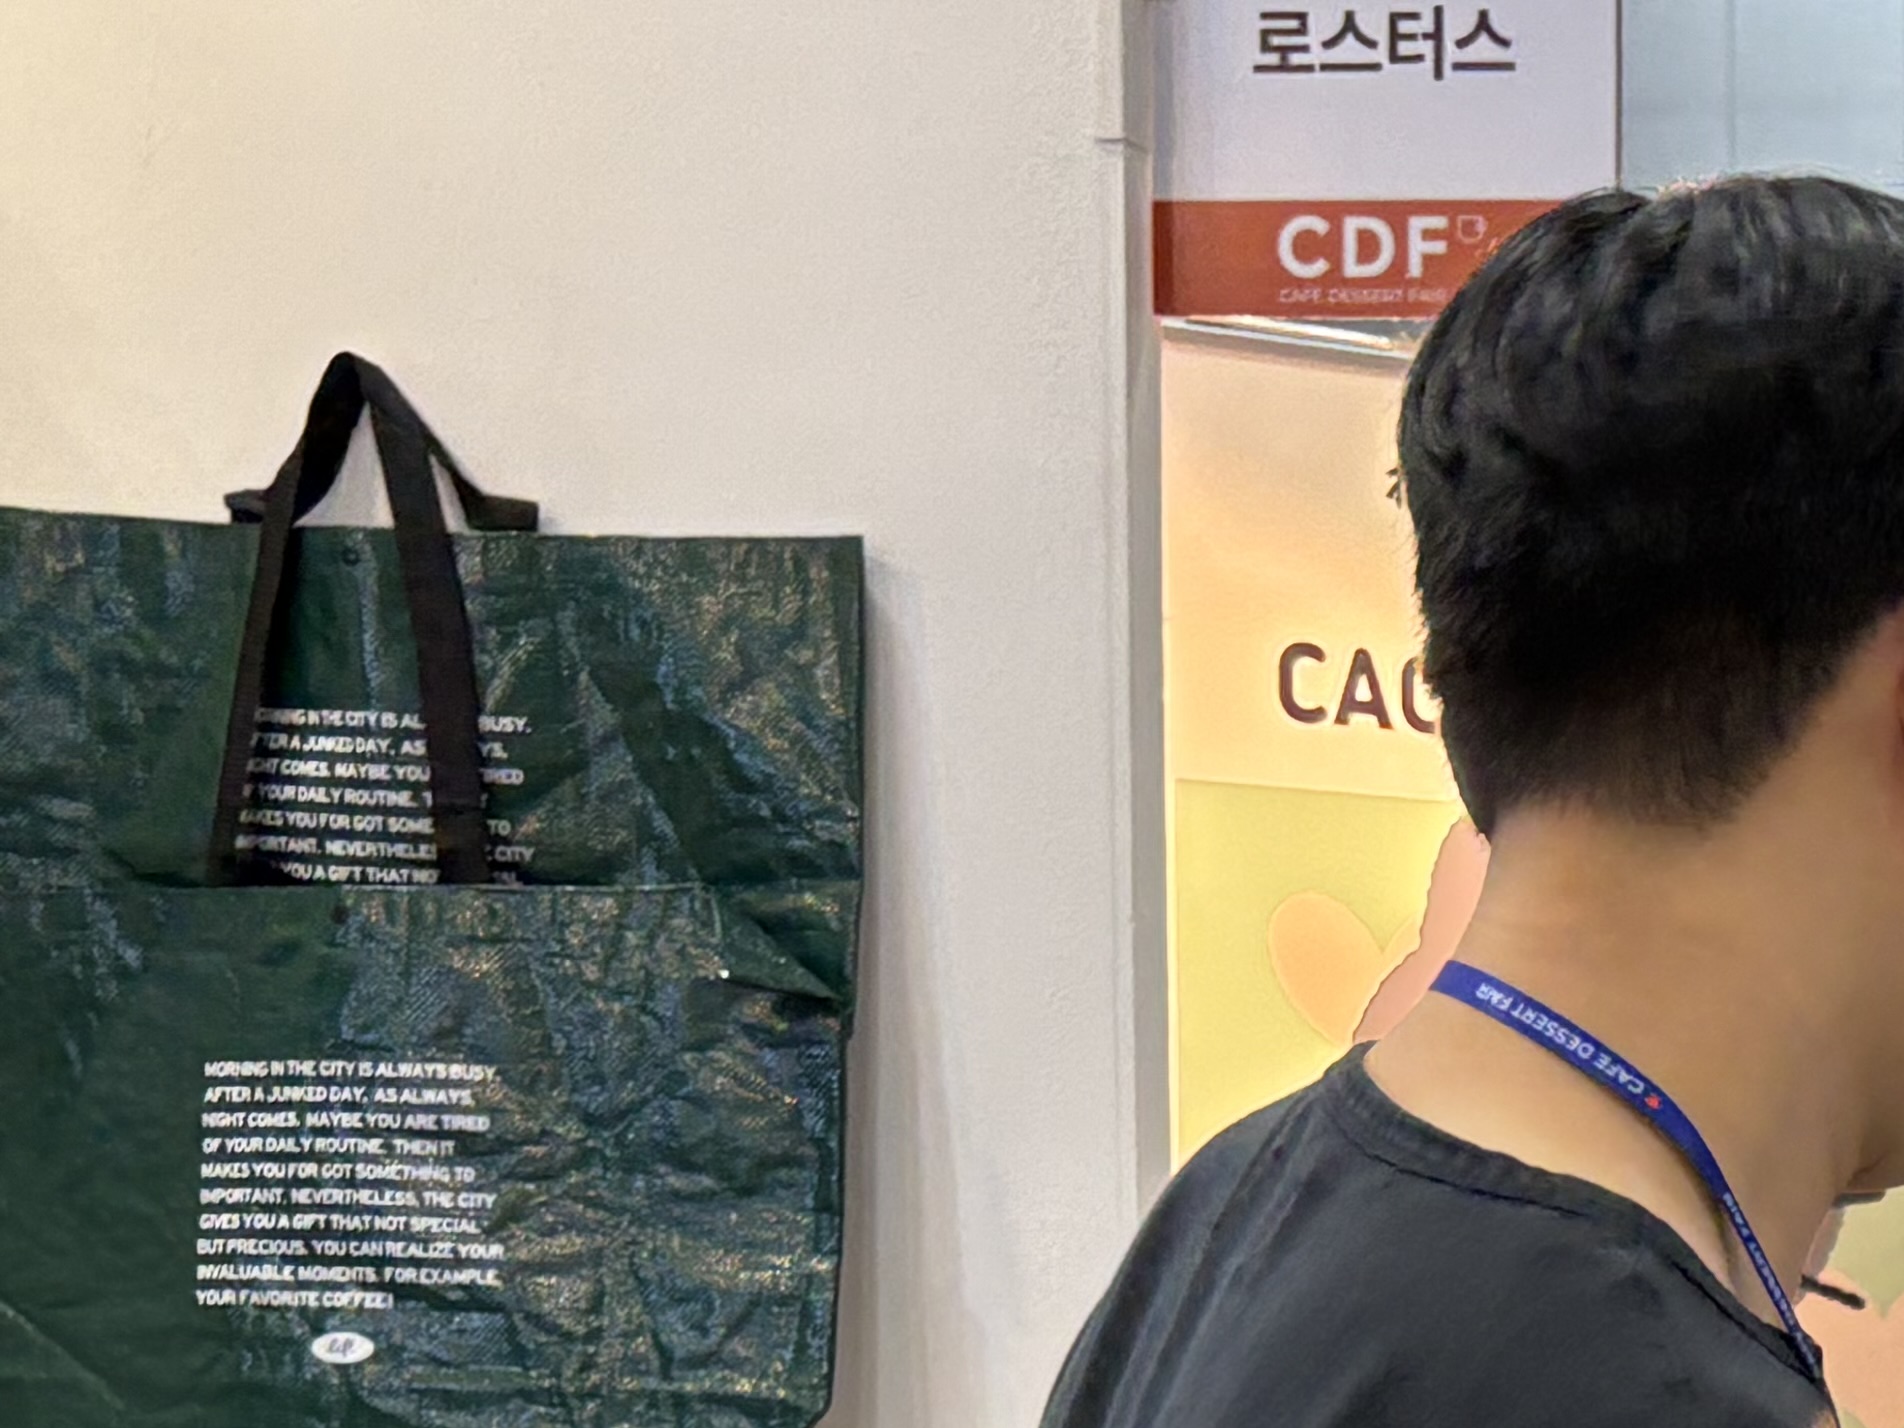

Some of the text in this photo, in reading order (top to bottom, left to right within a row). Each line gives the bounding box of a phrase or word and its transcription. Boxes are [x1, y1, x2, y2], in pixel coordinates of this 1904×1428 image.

[1252, 4, 1516, 81] 로스터스
[1278, 214, 1449, 279] CDF
[1511, 1003, 1597, 1060] DESSERT
[319, 1061, 356, 1080] CITY
[374, 1061, 447, 1081] ALWAYS
[1593, 1053, 1646, 1096] CAFE
[366, 1113, 400, 1131] YOU
[251, 1163, 287, 1181] YOU
[456, 1190, 498, 1210] CITY
[241, 1214, 277, 1232] YOU
[276, 1214, 290, 1232] A
[329, 1215, 373, 1233] THAT
[373, 1215, 409, 1234] NOT
[311, 1239, 347, 1258] YOU
[195, 1289, 239, 1309] YOUR
